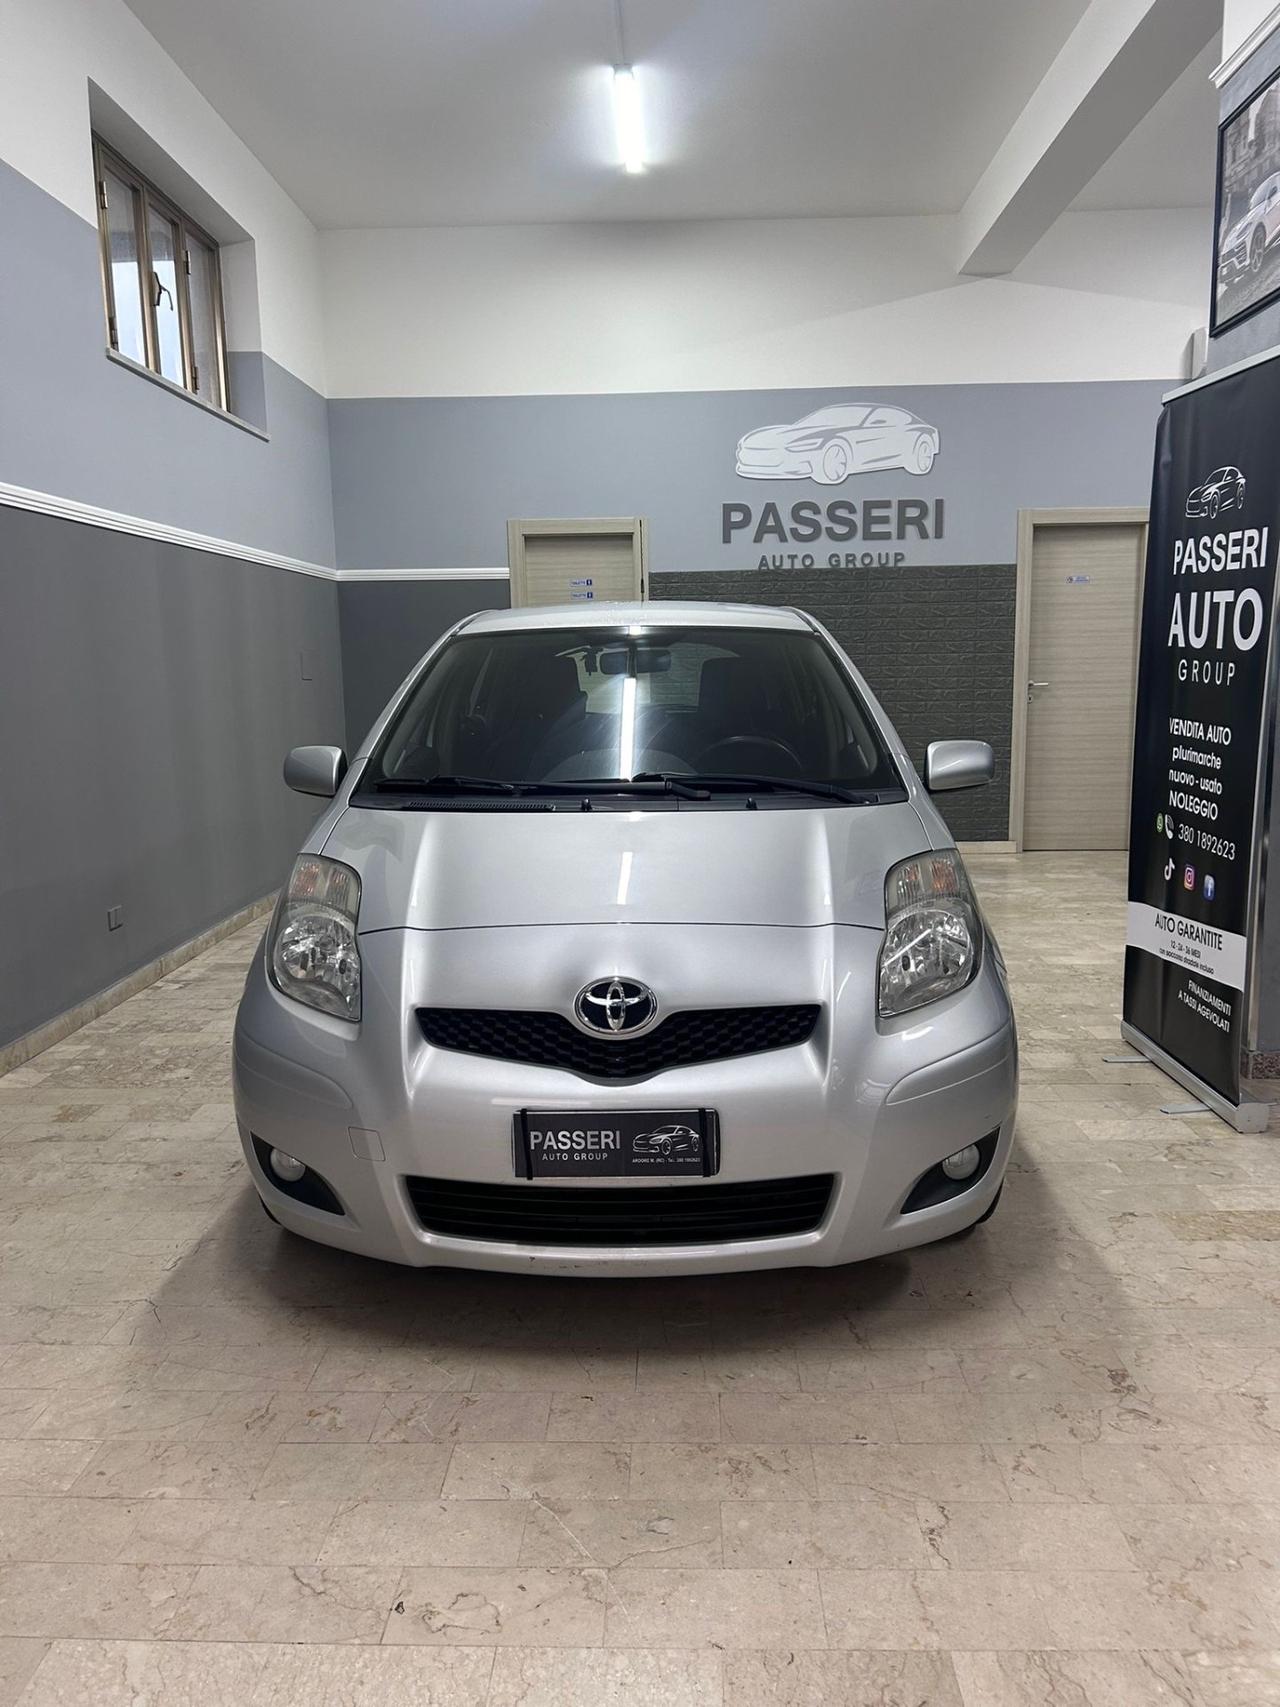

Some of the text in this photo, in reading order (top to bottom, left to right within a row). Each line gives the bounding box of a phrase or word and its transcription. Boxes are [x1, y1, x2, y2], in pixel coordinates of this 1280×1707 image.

[722, 499, 944, 544] PASSERI
[758, 552, 905, 570] AUTO GROUP
[1173, 527, 1269, 575] PASSERI
[1168, 588, 1263, 651] AUTO
[1178, 659, 1235, 686] GROUP
[1169, 717, 1232, 745] VENDITA AUTO
[1172, 745, 1222, 770] plurimarche
[1169, 769, 1195, 786] nuovo
[1200, 778, 1223, 795] usato
[1169, 790, 1218, 821] NOLEGGIO
[1178, 823, 1236, 860] 380 1892623
[1155, 913, 1223, 951] AUTO GARANTITE
[530, 1130, 620, 1150] PASSERI
[542, 1152, 608, 1161] AUTO GROUP
